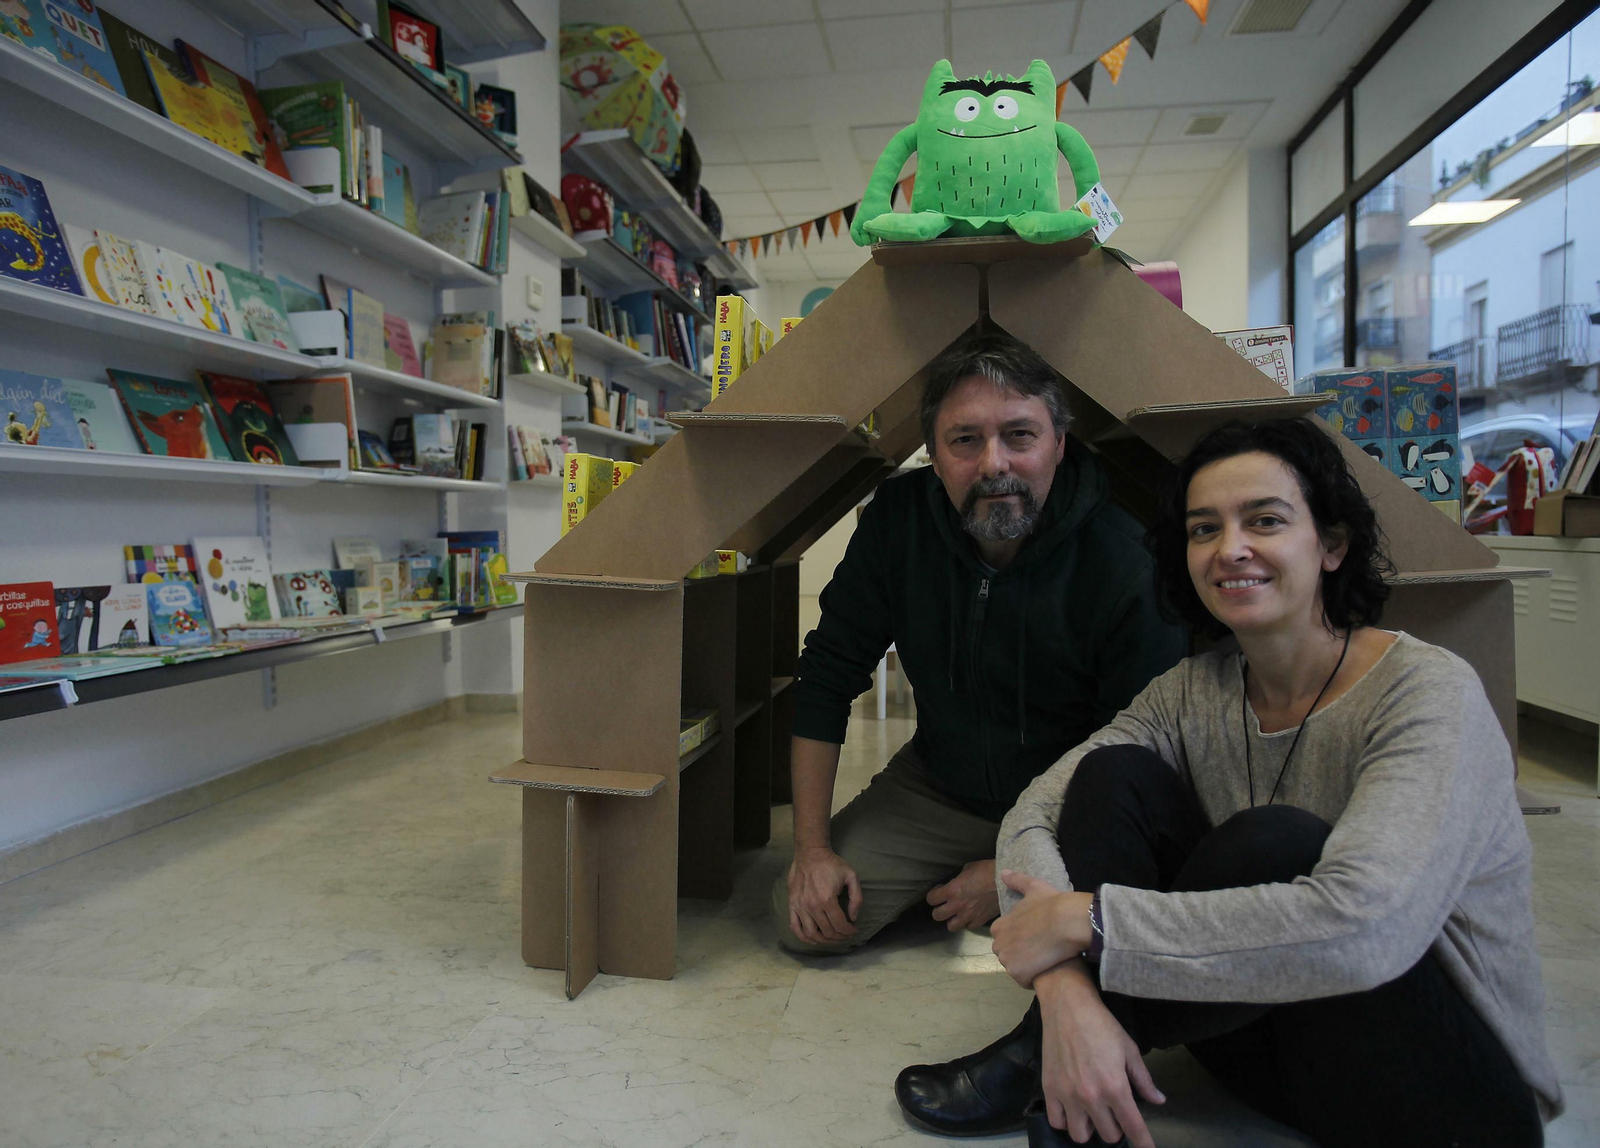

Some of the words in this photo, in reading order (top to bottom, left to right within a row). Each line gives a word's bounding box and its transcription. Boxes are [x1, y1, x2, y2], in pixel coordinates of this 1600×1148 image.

[46, 3, 102, 47] QUET
[719, 301, 730, 324] HABA
[569, 458, 579, 480] HABA
[613, 466, 621, 486] HABA
[6, 598, 51, 611] cosquillas
